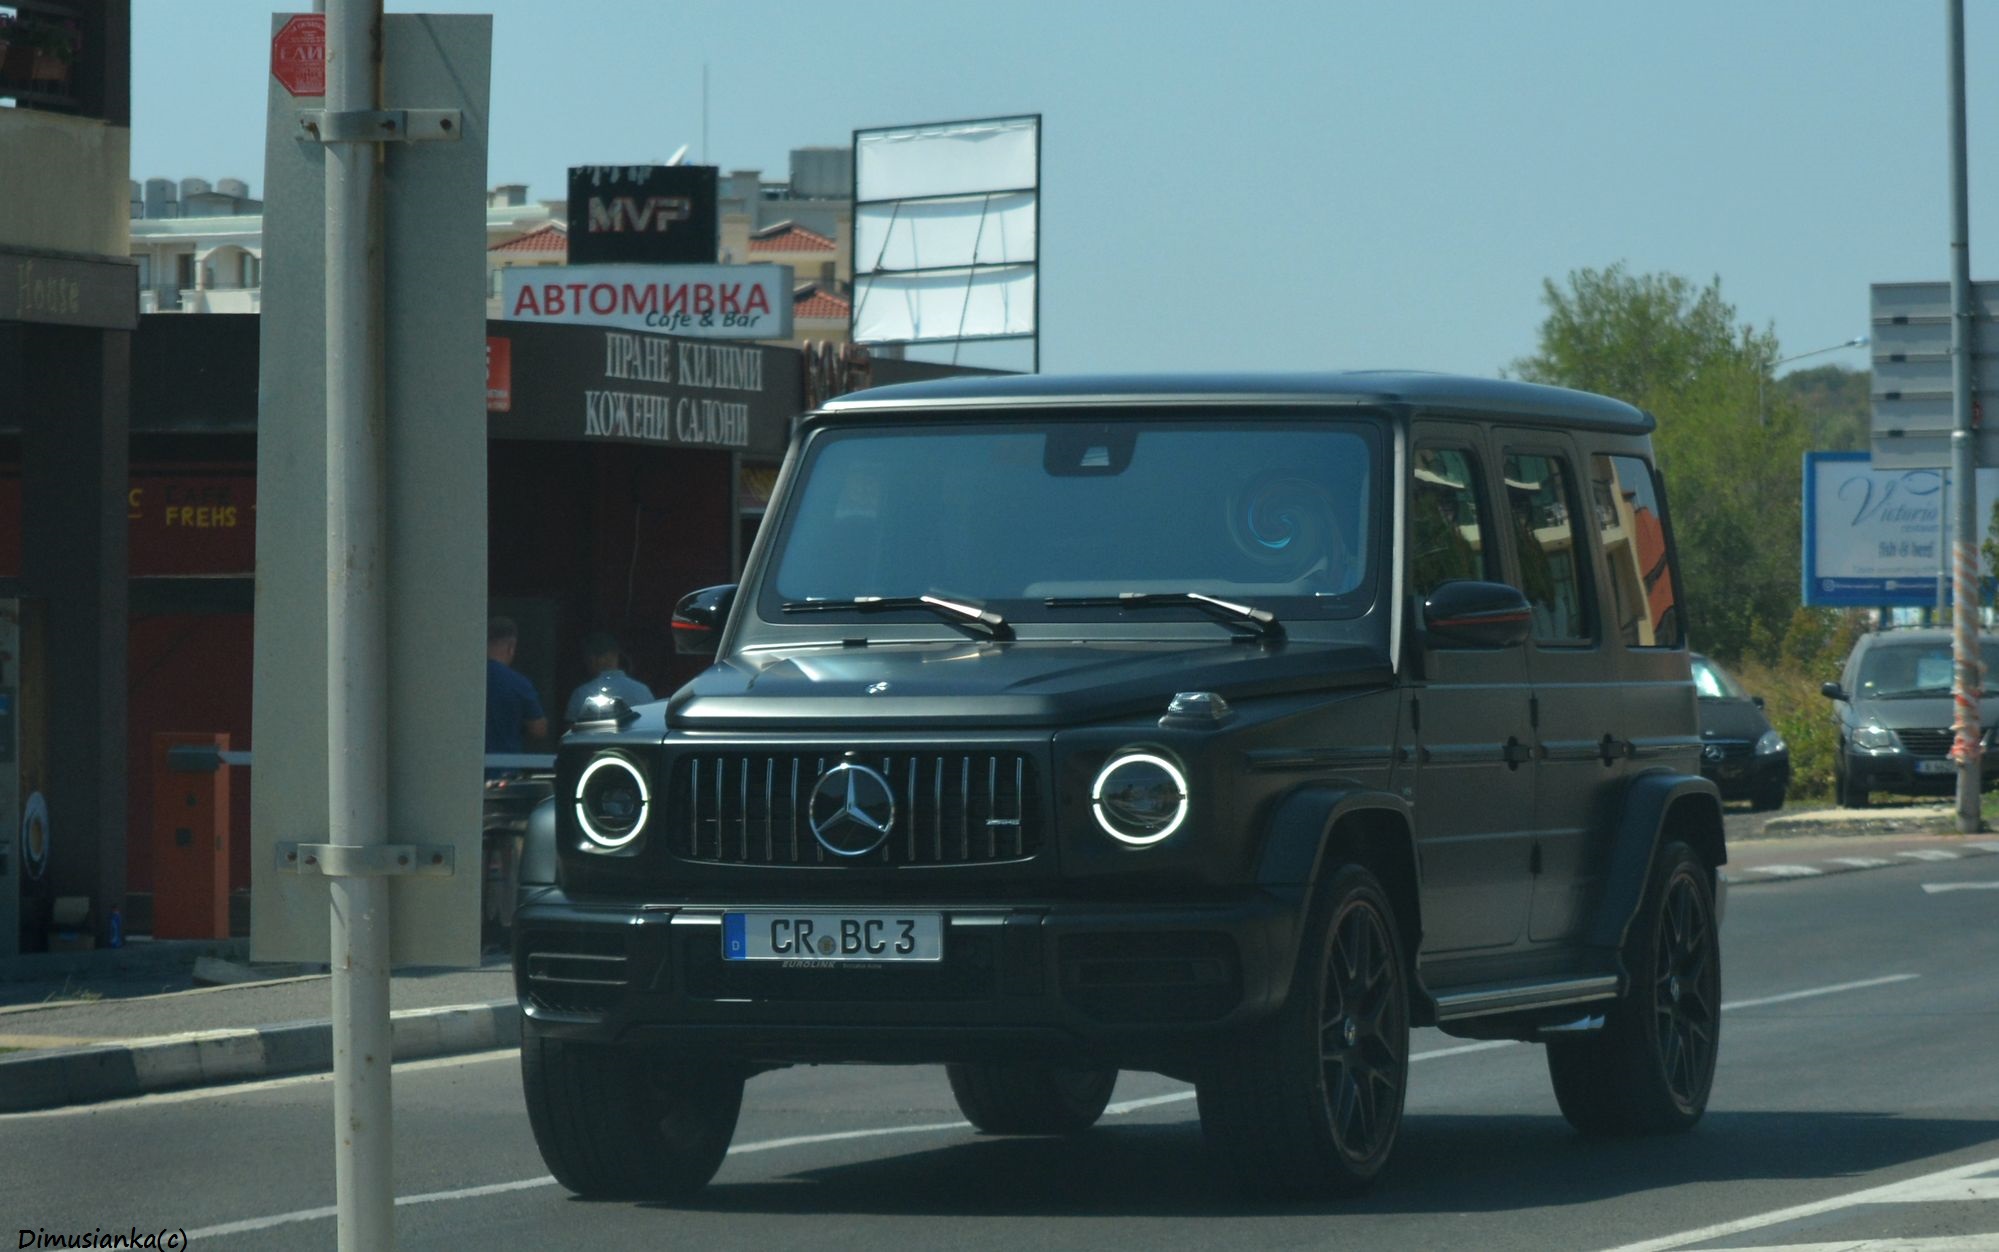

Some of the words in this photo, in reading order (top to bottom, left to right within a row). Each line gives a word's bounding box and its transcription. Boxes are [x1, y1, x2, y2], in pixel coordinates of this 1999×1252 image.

[588, 197, 692, 232] MVP
[513, 283, 771, 316] АВТОМИВКА
[645, 308, 692, 331] Cafe
[699, 308, 715, 327] &
[722, 310, 761, 328] Bar
[604, 332, 671, 383] ПРАНЕ
[677, 341, 763, 392] КИЛИМИ
[584, 390, 670, 441] КОЖЕНИ
[676, 397, 749, 446] САЛОНИ
[166, 505, 237, 528] FREHS
[731, 940, 740, 951] D
[770, 919, 816, 955] CR
[839, 919, 887, 955] BC
[894, 919, 915, 955] 3
